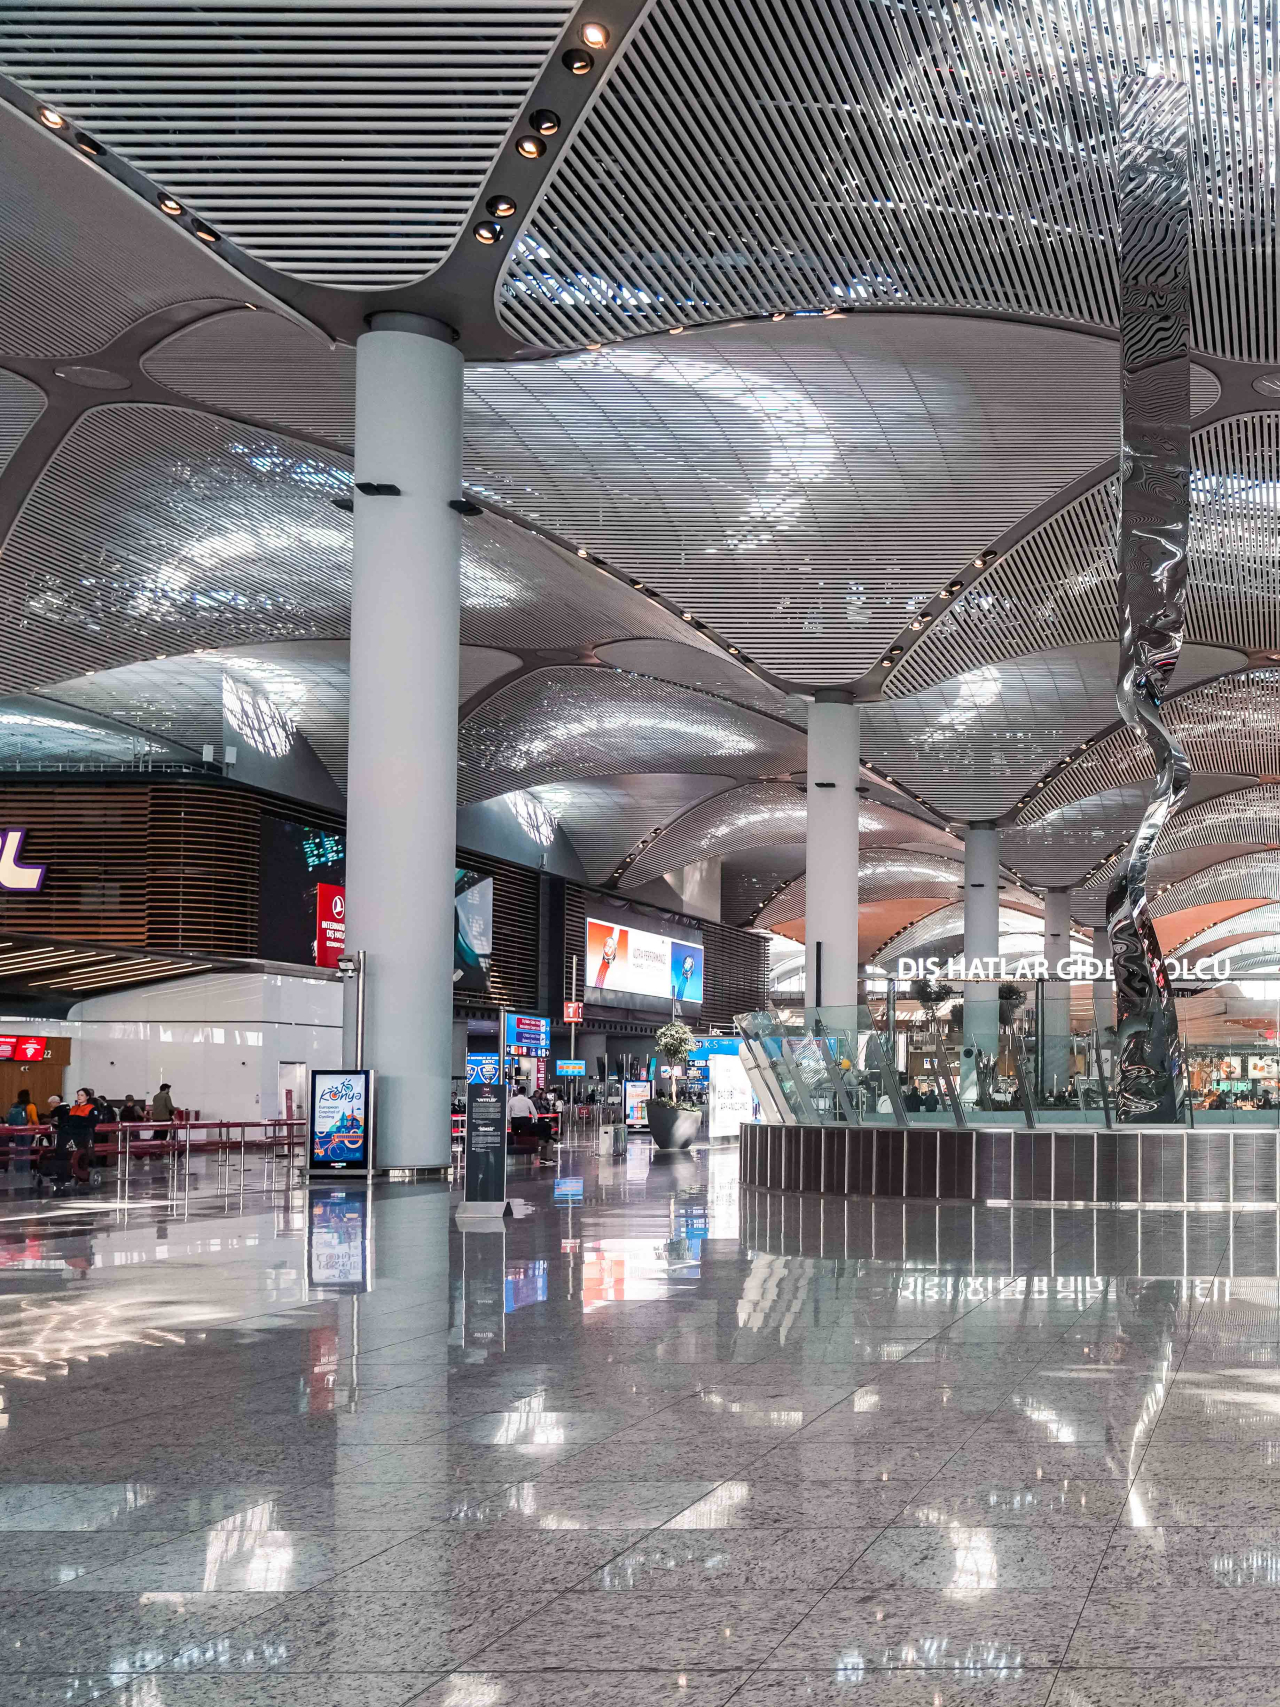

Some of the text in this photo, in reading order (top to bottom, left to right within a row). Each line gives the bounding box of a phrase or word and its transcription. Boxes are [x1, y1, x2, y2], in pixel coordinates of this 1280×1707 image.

[0, 829, 44, 890] L
[898, 953, 1231, 986] DIŞ HATLAR GİDE OLCU
